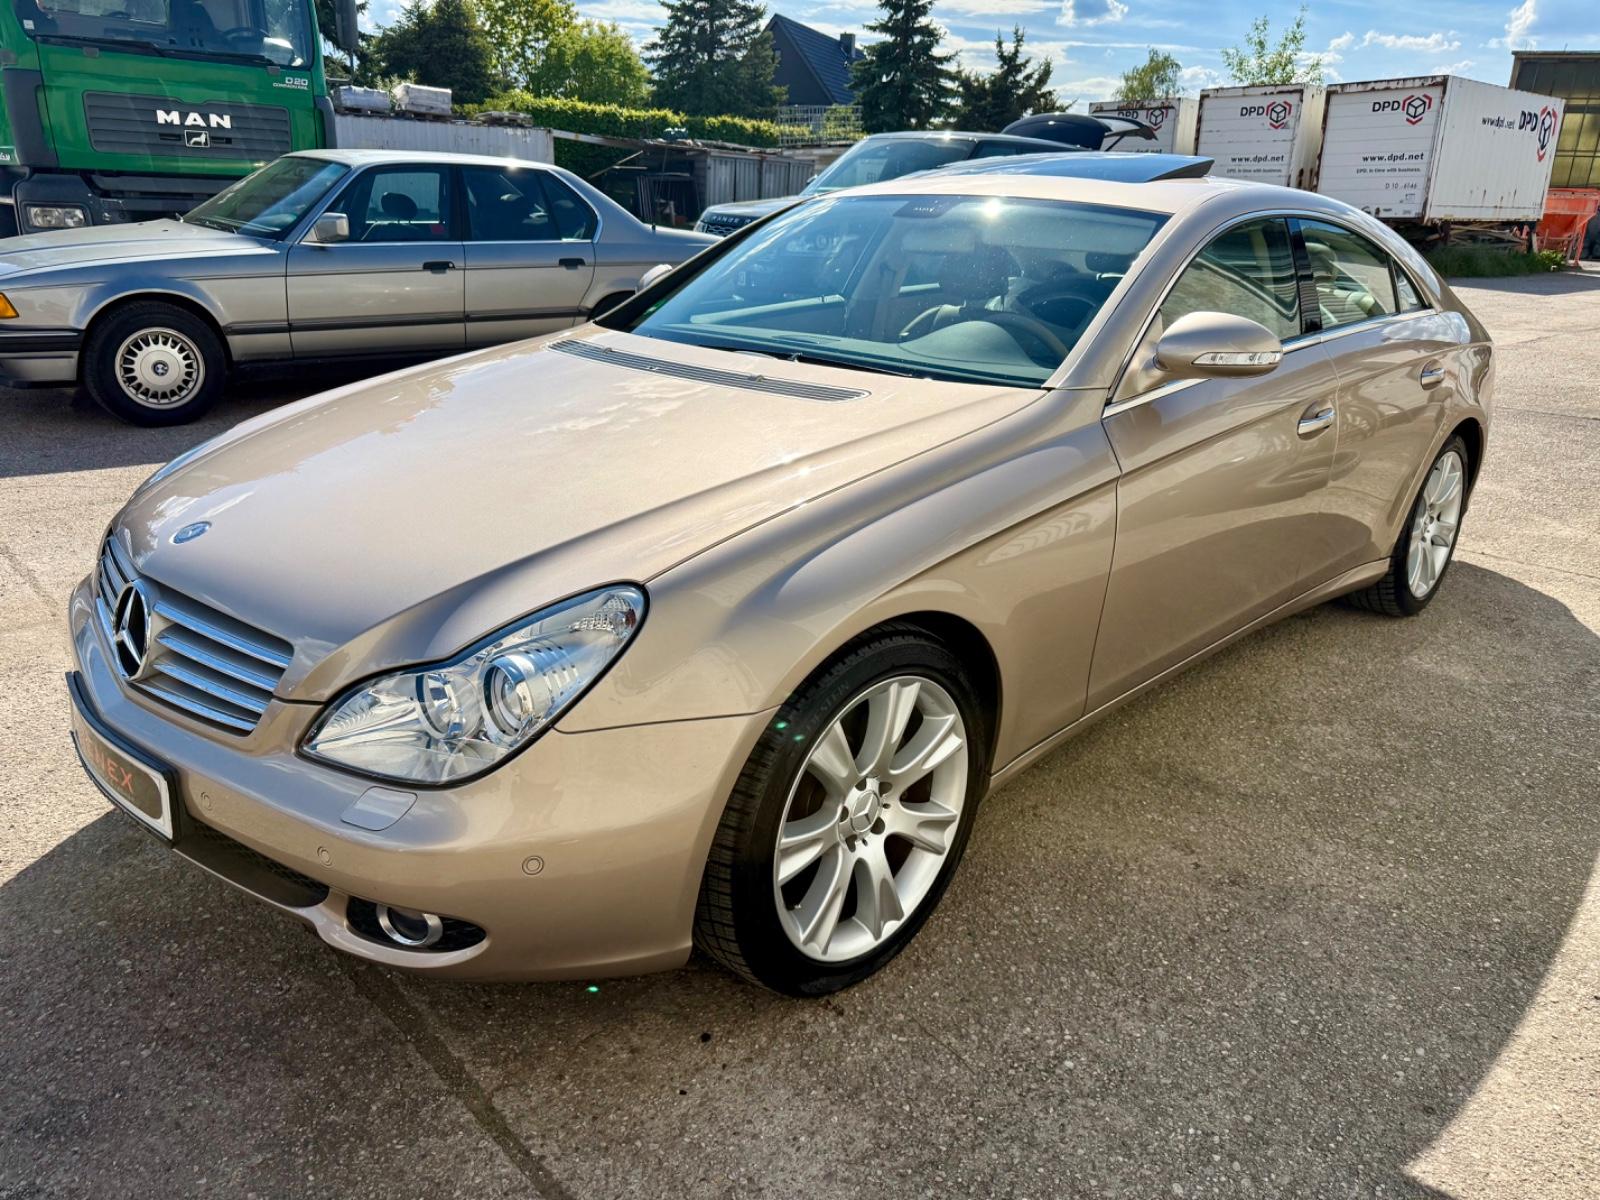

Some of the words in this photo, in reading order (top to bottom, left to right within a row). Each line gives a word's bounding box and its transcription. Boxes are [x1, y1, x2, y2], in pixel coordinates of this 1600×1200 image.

[1240, 106, 1265, 116] DPD
[1372, 100, 1401, 112] DPD
[156, 109, 231, 129] MAN
[1518, 110, 1538, 131] DPD
[1362, 152, 1424, 162] www.dpd.net
